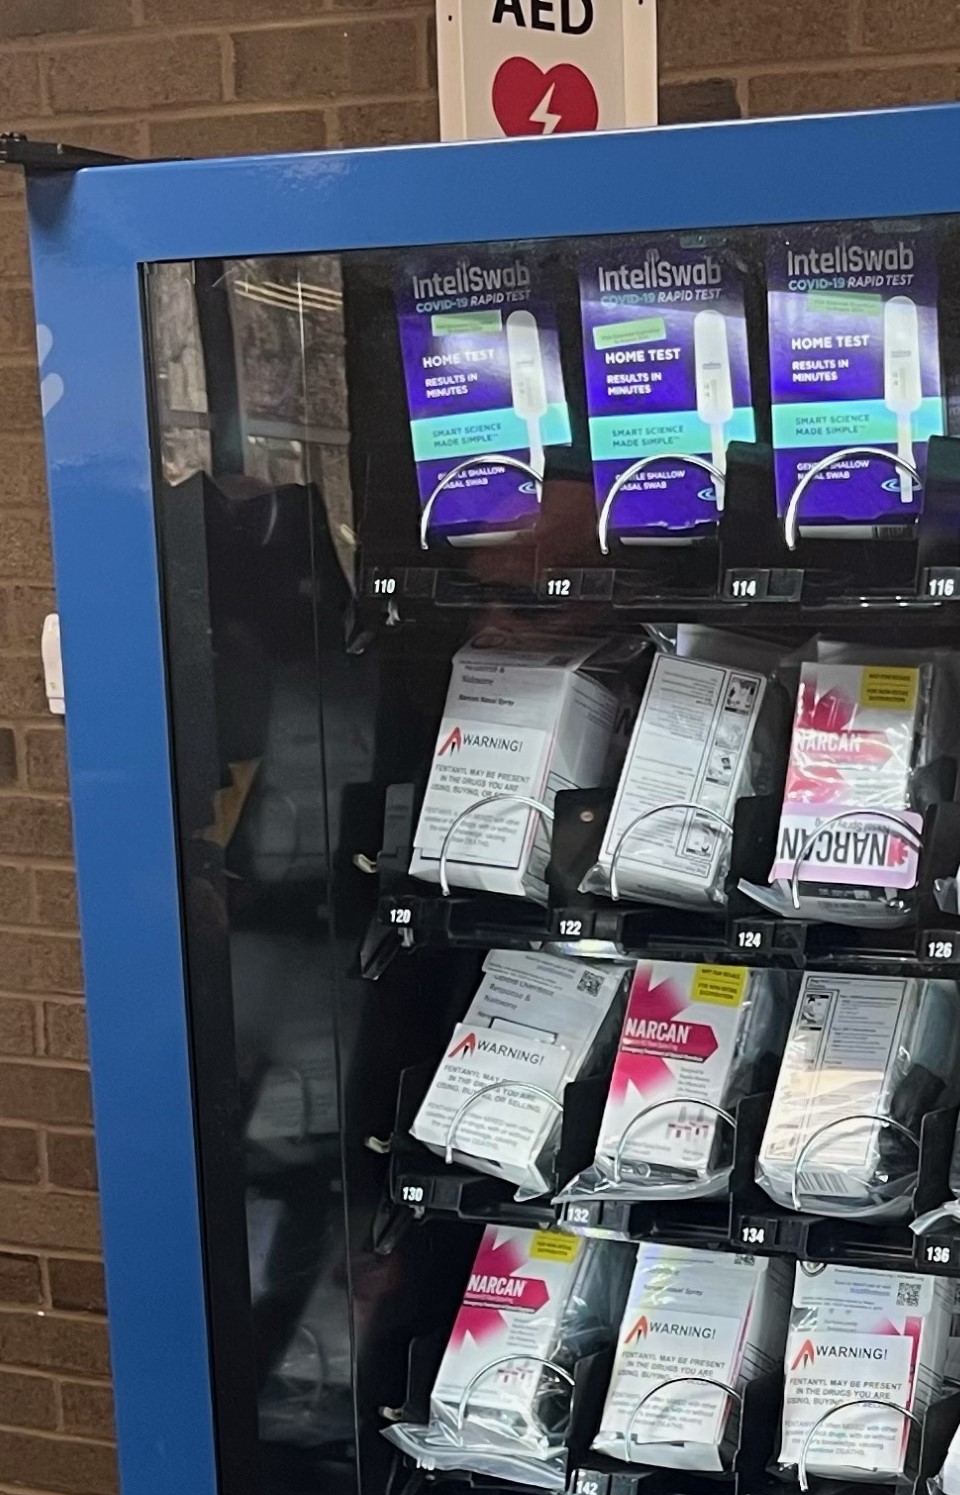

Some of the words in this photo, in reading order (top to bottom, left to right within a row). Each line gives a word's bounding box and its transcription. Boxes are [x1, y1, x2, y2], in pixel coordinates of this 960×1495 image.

[493, 0, 593, 35] AED
[789, 277, 845, 291] COVID-19
[847, 275, 884, 288] RAPID
[885, 274, 913, 286] TEST
[416, 297, 468, 313] COVID-19
[470, 293, 505, 306] RAPID
[505, 290, 531, 302] TEST
[600, 292, 655, 307] COVID-19
[657, 290, 692, 303] RAPID
[694, 287, 721, 300] TEST
[791, 336, 833, 350] HOME
[836, 335, 869, 347] TEST
[423, 352, 460, 368] HOME
[464, 349, 494, 363] TEST
[605, 350, 645, 364] HOME
[647, 348, 681, 362] TEST
[792, 360, 835, 371] RESULTS
[837, 359, 849, 369] IN
[425, 374, 466, 388] RESULTS
[467, 373, 478, 383] IN
[606, 374, 647, 385] RESULTS
[650, 372, 662, 382] IN
[792, 371, 838, 383] MINUTES
[427, 385, 469, 398] MINUTES
[607, 383, 652, 396] MINUTES
[796, 416, 826, 426] SMART
[830, 414, 869, 424] SCIENCE
[432, 426, 462, 437] SMART
[465, 423, 501, 435] SCIENCE
[612, 428, 642, 438] SMART
[644, 425, 683, 436] SCIENCE
[796, 427, 823, 436] MADE
[433, 437, 460, 448] MADE
[612, 438, 639, 448] MADE
[374, 579, 395, 593] 110
[548, 580, 570, 595] 112
[732, 581, 756, 596] 114
[930, 579, 954, 596] 116
[463, 734, 523, 752] WARNING!
[390, 909, 411, 923] 120
[560, 921, 581, 935] 122
[739, 932, 761, 947] 124
[928, 942, 952, 957] 126
[625, 1018, 691, 1044] NARCAN
[478, 1040, 544, 1065] WARNING!
[402, 1188, 423, 1201] 130
[568, 1208, 589, 1223] 132
[743, 1228, 764, 1243] 134
[926, 1247, 950, 1263] 136
[467, 1274, 526, 1298] NARCAN
[650, 1322, 716, 1340] WARNING!
[816, 1346, 888, 1360] WARNING!
[576, 1481, 598, 1495] 142
